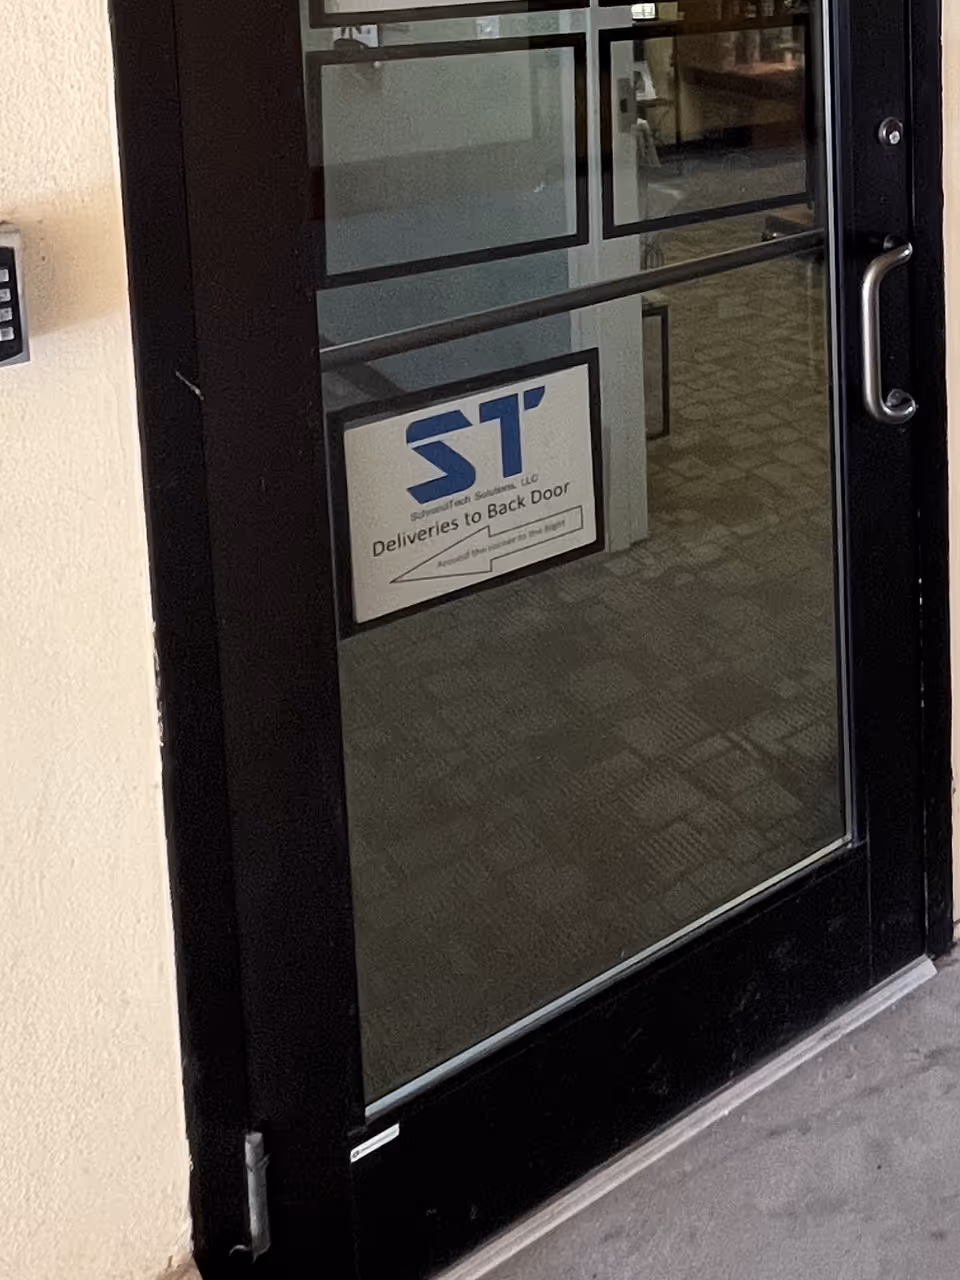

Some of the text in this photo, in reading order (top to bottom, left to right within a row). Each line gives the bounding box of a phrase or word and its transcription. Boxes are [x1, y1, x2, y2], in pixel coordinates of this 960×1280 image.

[521, 473, 539, 488] LLC
[372, 481, 570, 558] Deliveries to Back Door
